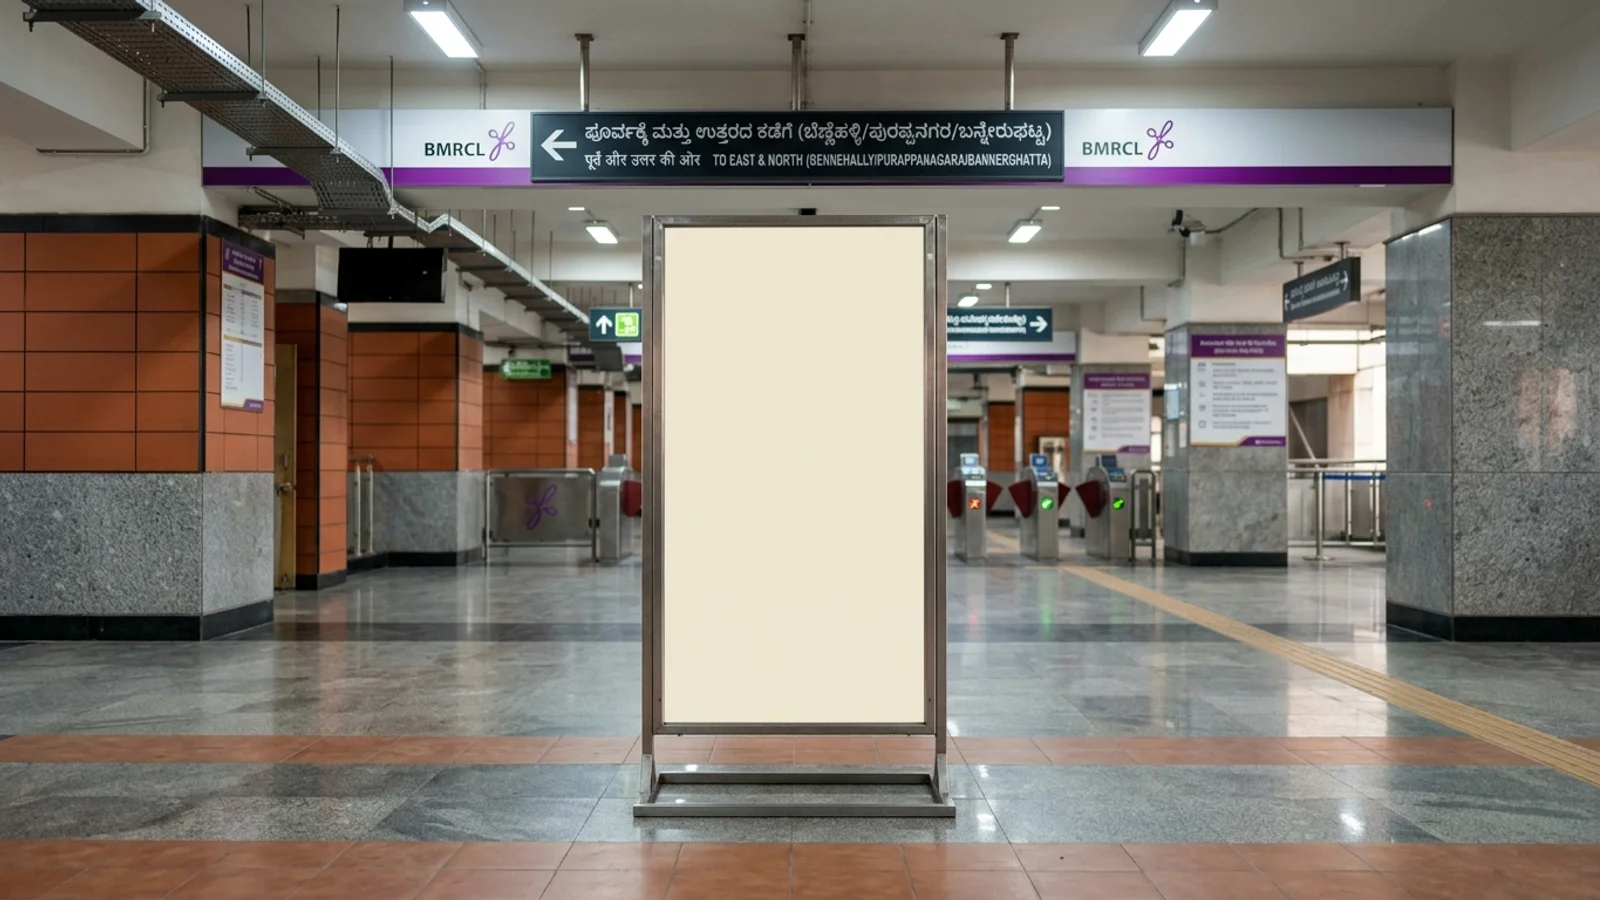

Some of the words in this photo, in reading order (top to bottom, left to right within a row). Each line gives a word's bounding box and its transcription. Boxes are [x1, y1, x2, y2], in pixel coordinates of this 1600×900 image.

[652, 123, 692, 146] ಮತ್ತು
[757, 122, 793, 140] ಕಡೆಗೆ
[424, 142, 485, 157] BMRCL
[1081, 142, 1143, 157] BMRCL
[659, 149, 676, 167] की
[712, 153, 727, 168] TO
[729, 153, 756, 168] EAST
[757, 153, 767, 168] &
[768, 153, 803, 168] NORTH
